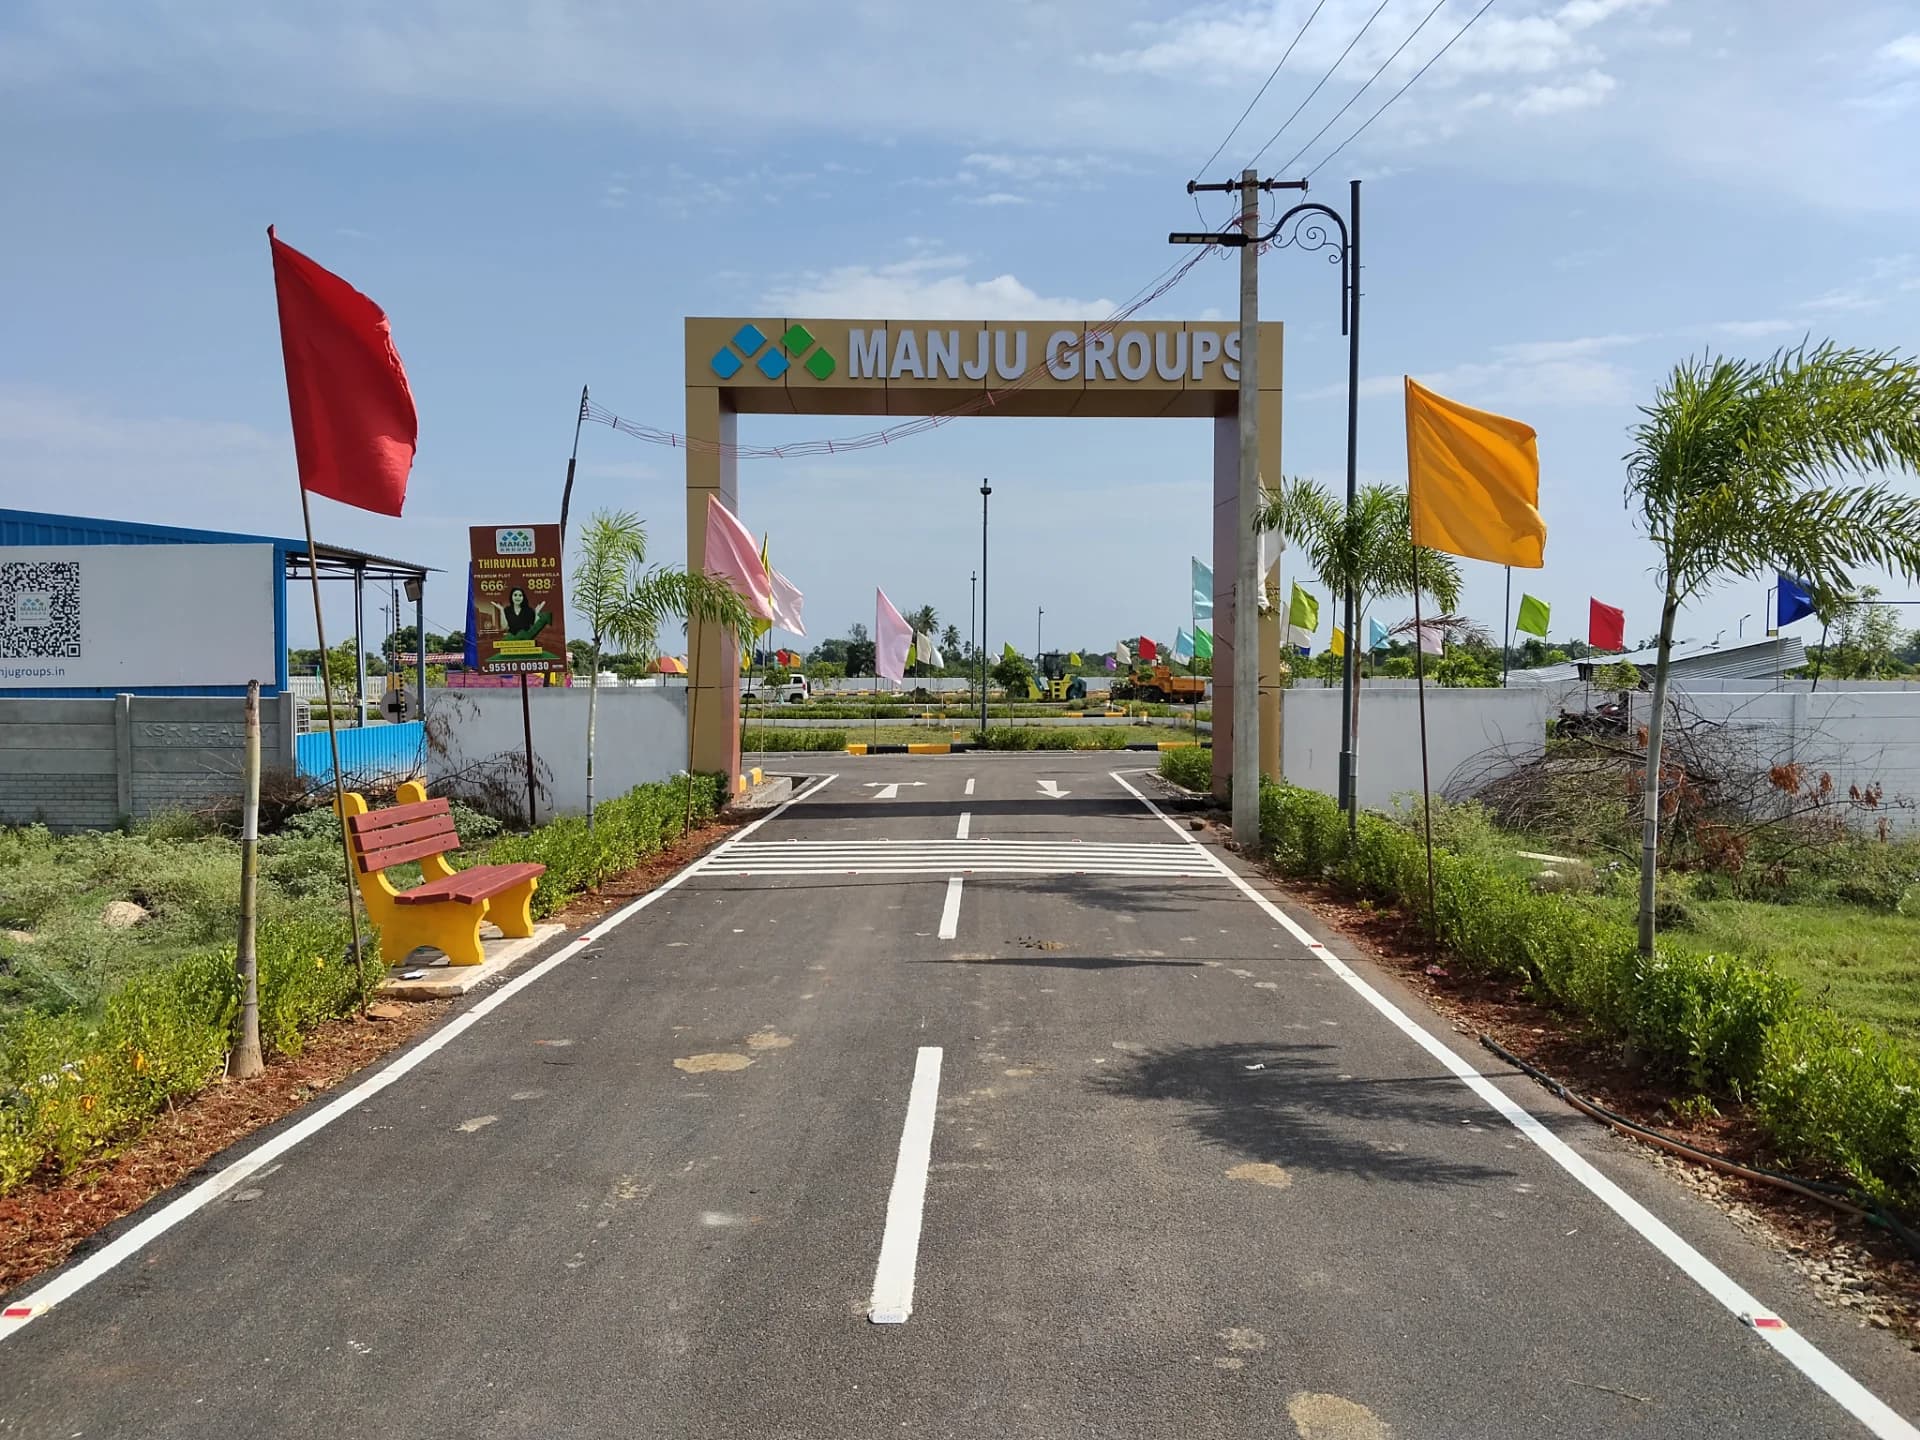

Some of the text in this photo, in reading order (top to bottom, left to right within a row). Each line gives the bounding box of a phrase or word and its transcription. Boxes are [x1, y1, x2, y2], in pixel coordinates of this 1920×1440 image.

[848, 329, 1028, 380] MANJU
[478, 557, 556, 569] THIRUVALLUR 2.0
[489, 662, 518, 672] 95510
[520, 661, 549, 671] 00930
[190, 724, 271, 737] REALY
